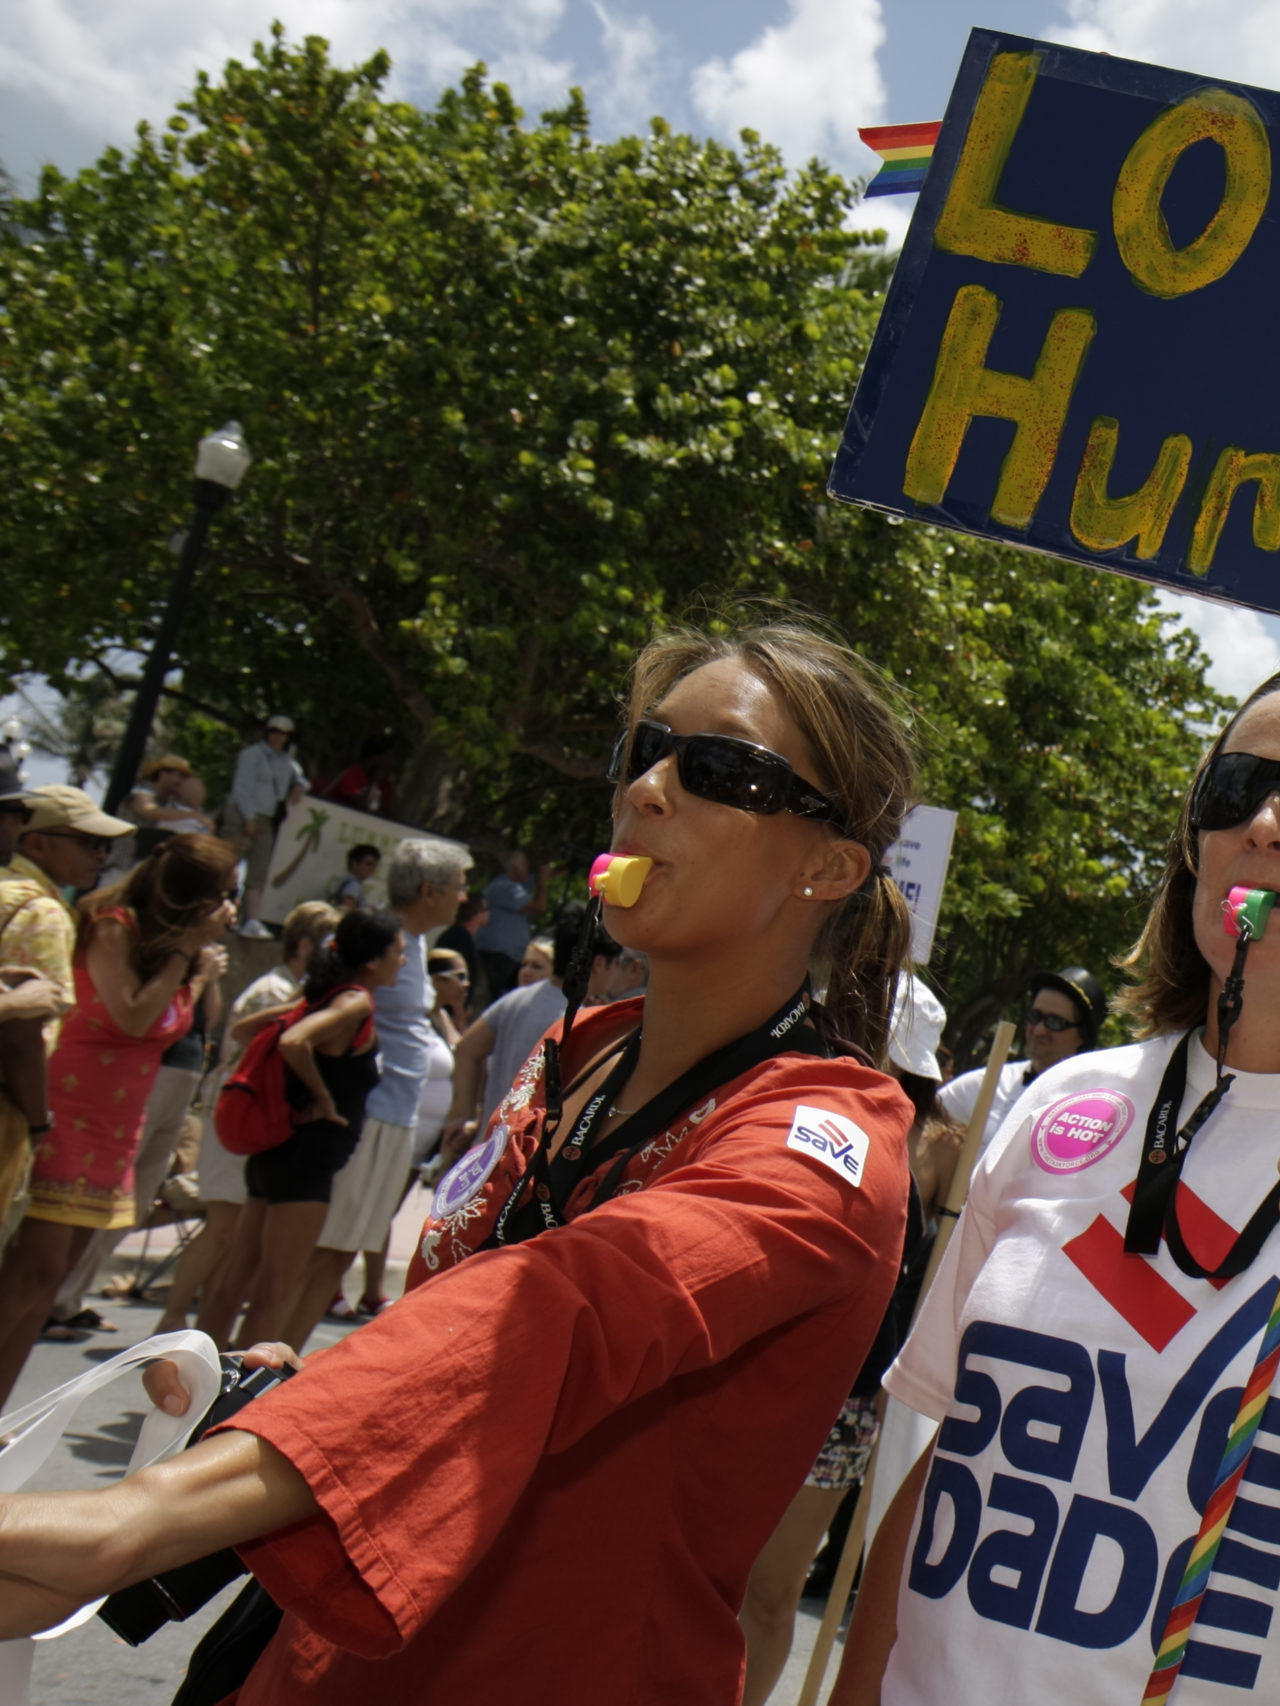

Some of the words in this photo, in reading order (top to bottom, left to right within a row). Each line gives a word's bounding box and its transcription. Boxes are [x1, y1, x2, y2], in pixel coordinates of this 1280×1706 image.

[1048, 1122, 1065, 1135] is
[1067, 1127, 1106, 1144] HOT
[1057, 1110, 1114, 1133] ACTION
[1153, 1099, 1173, 1149] BACARDI
